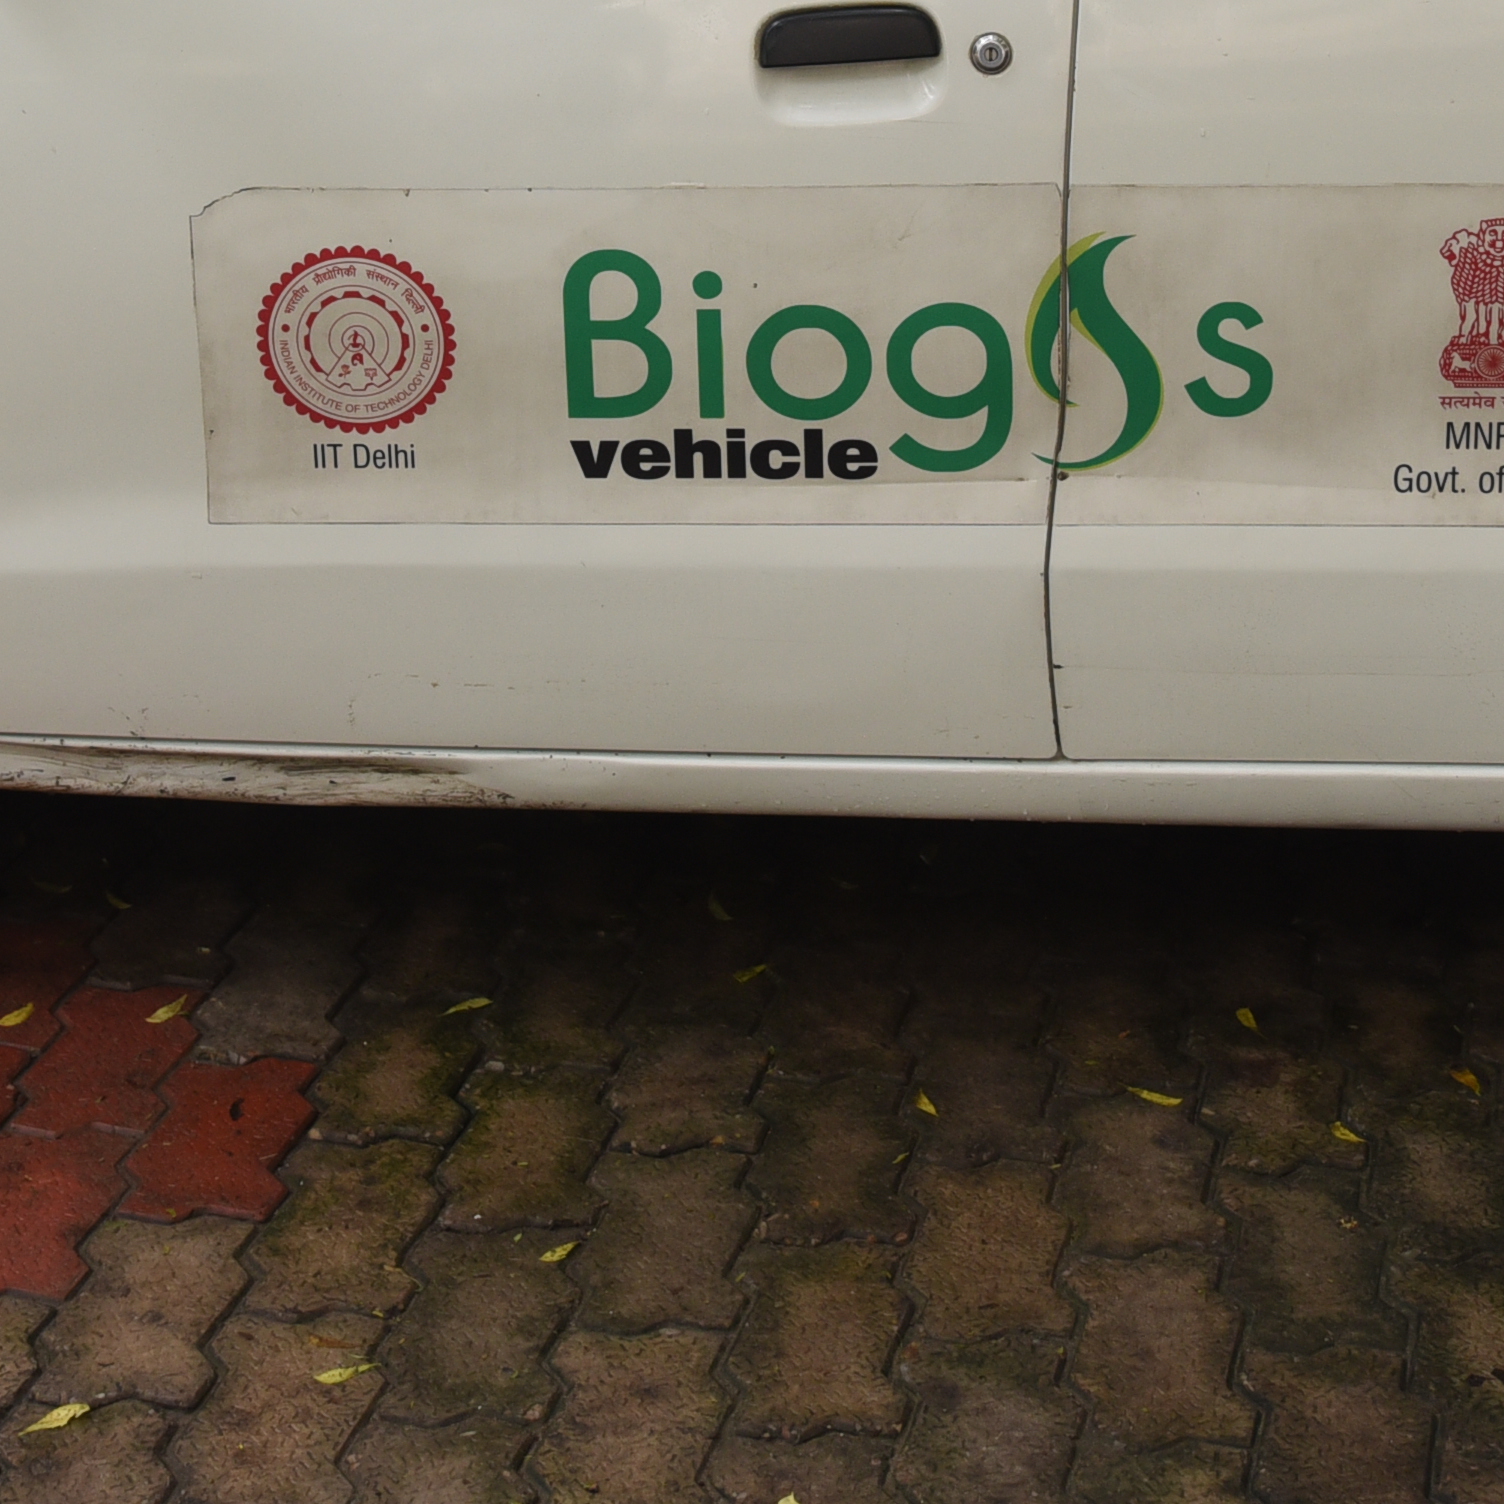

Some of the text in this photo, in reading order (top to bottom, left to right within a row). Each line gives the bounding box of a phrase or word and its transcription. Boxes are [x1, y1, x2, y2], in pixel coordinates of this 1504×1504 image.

[284, 265, 426, 315] भारतीय प्रौद्योगिकी संस्थान दिल्ली
[279, 339, 434, 413] INDIAN INSTITUTE OF TECHNOLOGY DELHI
[1438, 391, 1497, 410] सत्यमेव
[312, 443, 416, 470] IIT Delhi
[569, 427, 879, 481] vehicle
[1393, 464, 1466, 494] Govt.
